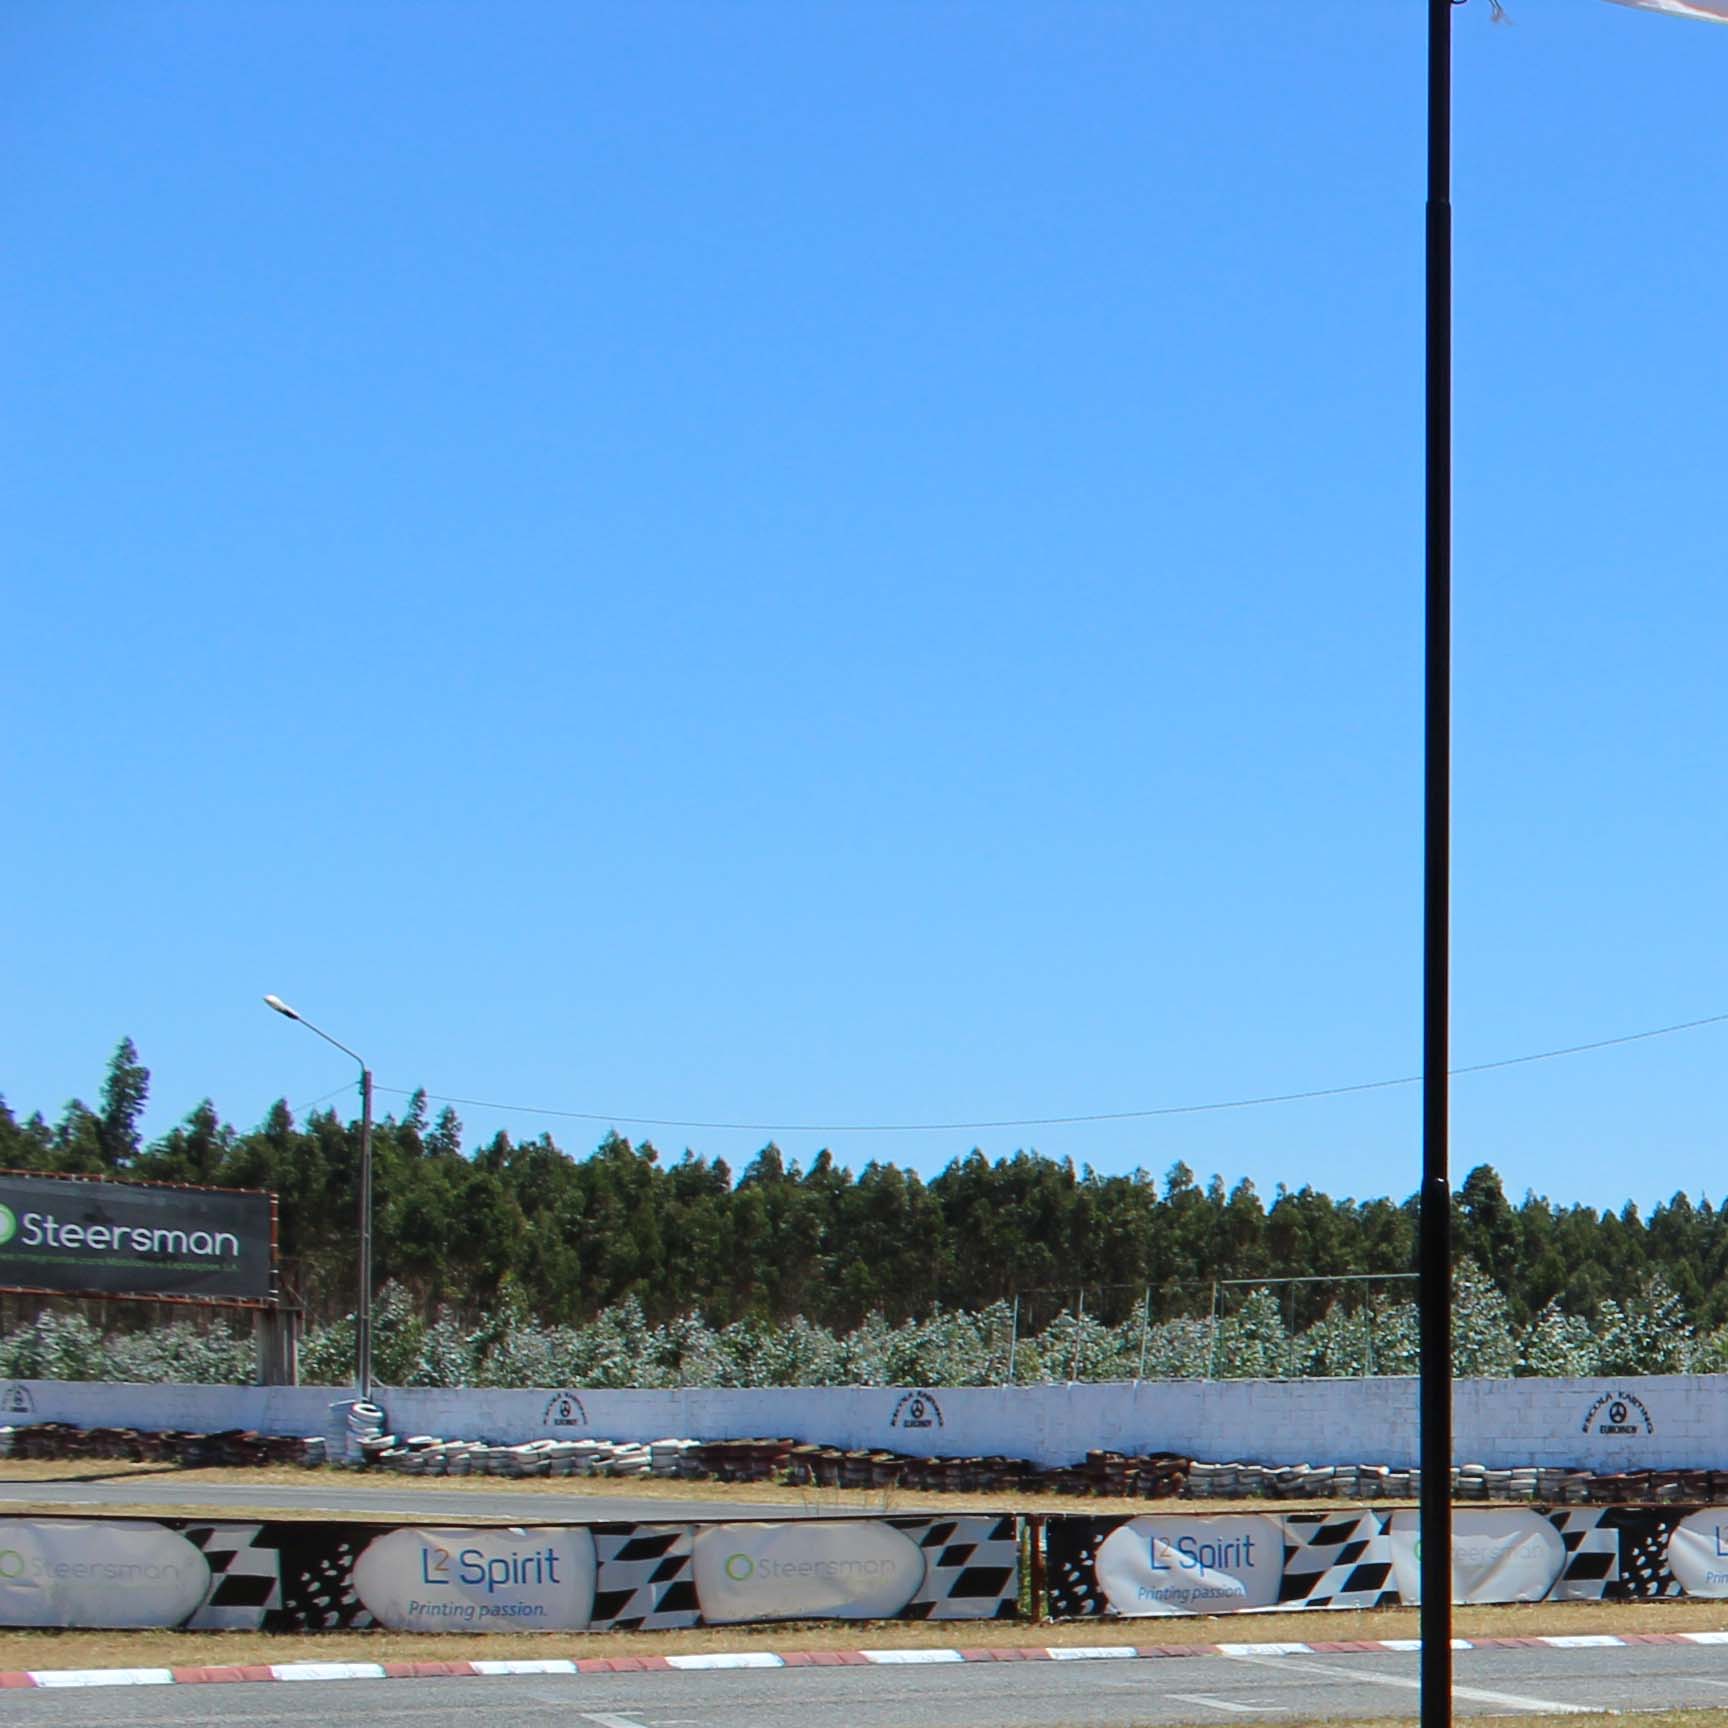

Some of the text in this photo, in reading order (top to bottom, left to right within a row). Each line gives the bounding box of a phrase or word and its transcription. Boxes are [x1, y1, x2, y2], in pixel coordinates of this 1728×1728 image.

[21, 1212, 239, 1256] Steersman
[459, 1548, 560, 1593] Spirit
[1178, 1534, 1255, 1578] Spirit
[408, 1600, 475, 1621] Printing
[1137, 1586, 1189, 1604] Printing
